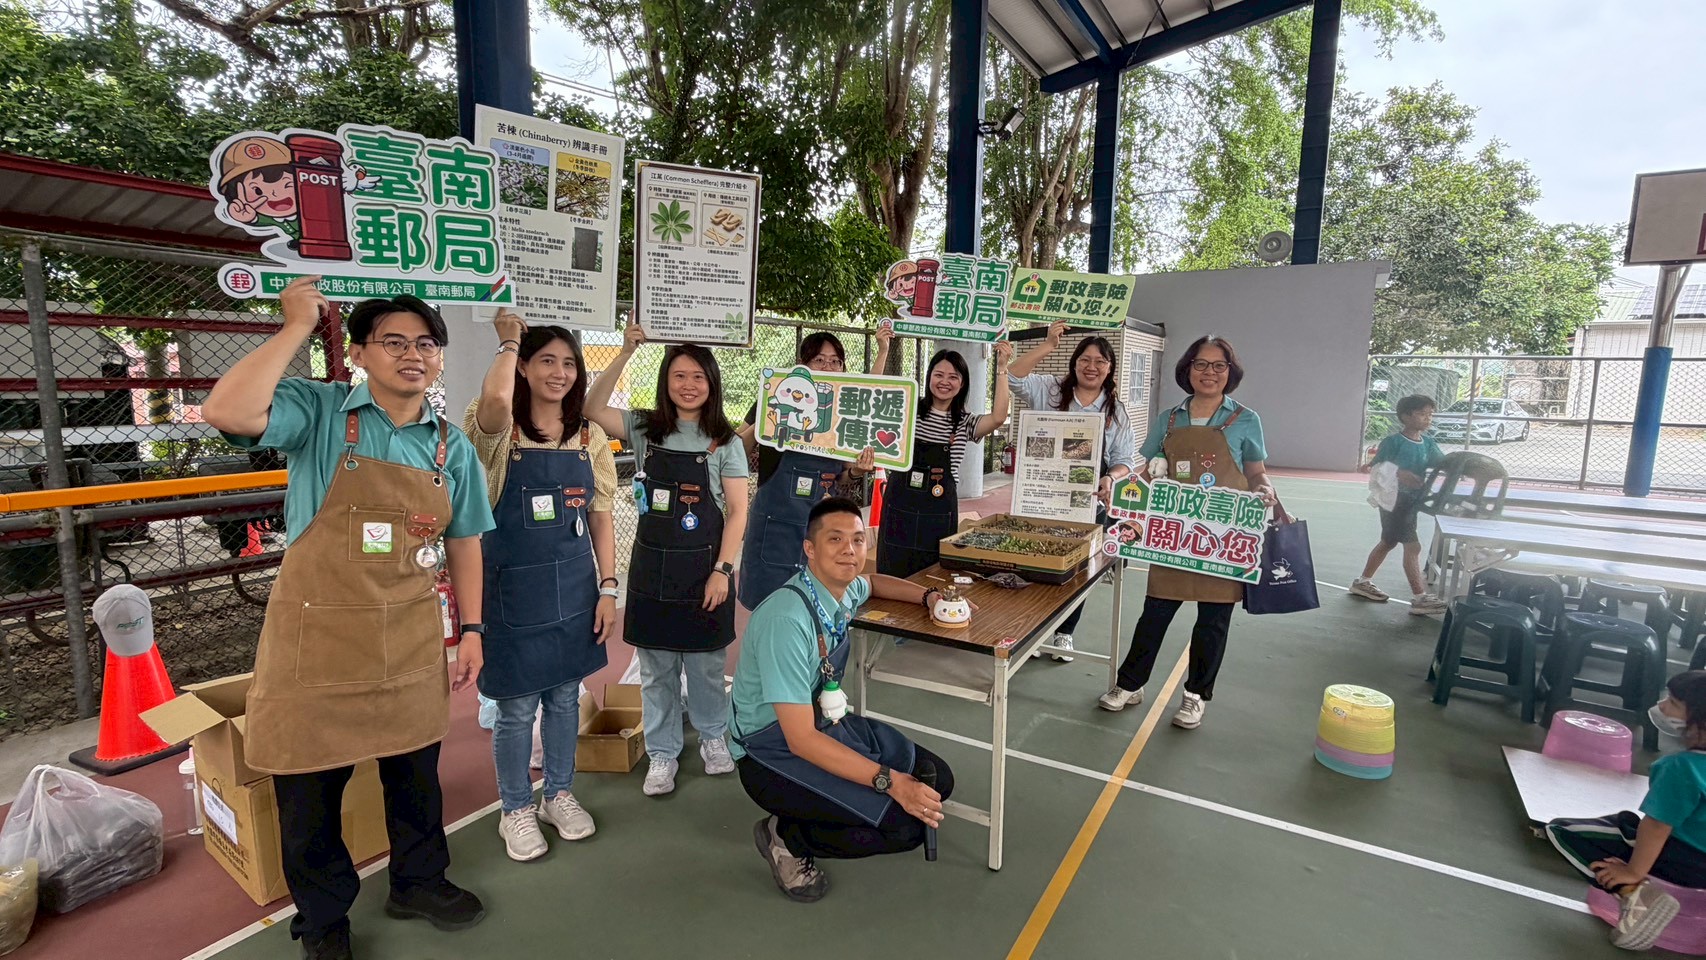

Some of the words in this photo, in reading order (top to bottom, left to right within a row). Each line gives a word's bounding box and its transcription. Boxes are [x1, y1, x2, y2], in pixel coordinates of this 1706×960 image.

[519, 128, 571, 148] (Chinaberry)
[299, 172, 338, 186] POST
[346, 130, 491, 210] 臺南
[664, 174, 690, 183] (Common
[356, 208, 496, 274] 郵局
[270, 276, 415, 295] 中政股份有限公司
[425, 284, 476, 298] 臺南郵局
[938, 256, 1008, 292] 臺南
[1049, 279, 1128, 300] 郵政壽險
[935, 292, 1004, 326] 郵局
[896, 324, 958, 336] 中華郵政股份有限公司
[962, 330, 987, 339] 臺南郵局
[838, 386, 904, 422] 郵遞
[1150, 483, 1265, 530] 郵政壽險
[1146, 518, 1259, 564] 關心您
[1123, 548, 1197, 568] 中華郵政股份有限公司
[1202, 562, 1234, 574] 臺南郵局
